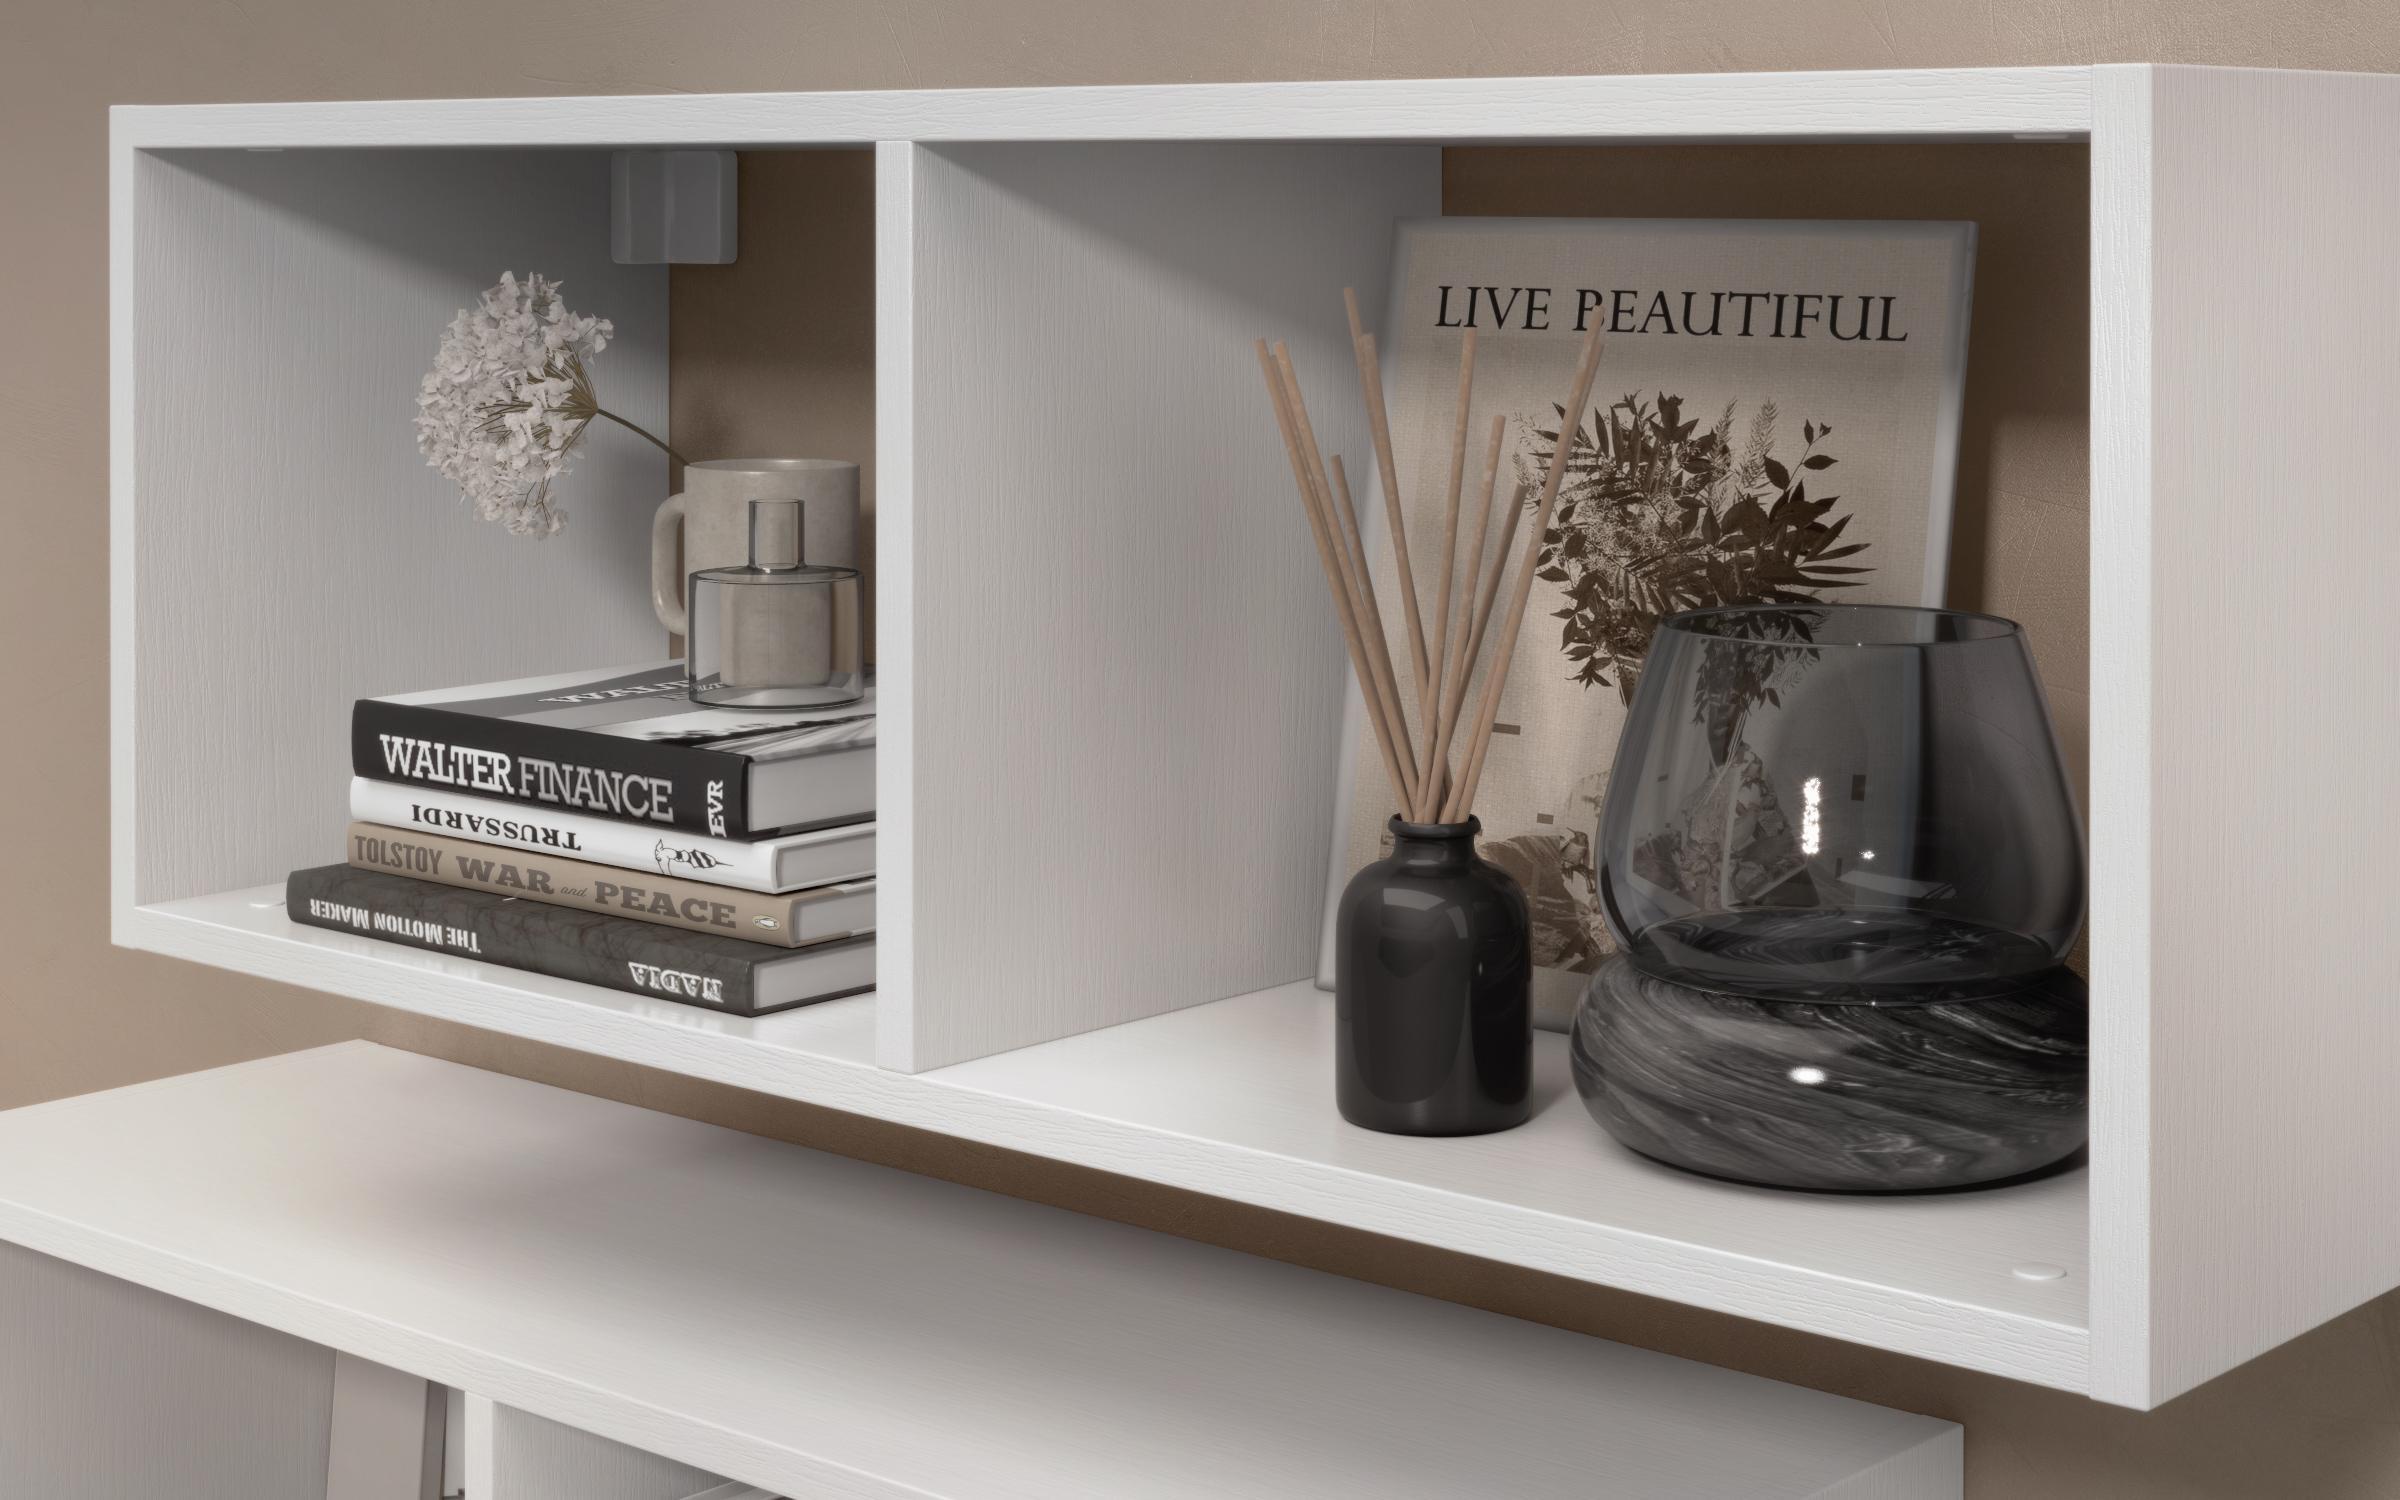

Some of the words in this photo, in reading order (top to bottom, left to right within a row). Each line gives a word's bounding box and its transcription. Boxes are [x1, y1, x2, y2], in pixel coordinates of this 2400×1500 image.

[1435, 285, 1553, 331] LIVE
[379, 733, 515, 795] WALTER
[517, 756, 674, 823] FINANCE
[411, 804, 582, 851] TRUSSARDI
[707, 779, 727, 838] EVR
[355, 835, 443, 875] TOLSTOY
[456, 855, 555, 895] WAR
[560, 886, 588, 898] and
[594, 880, 737, 929] PEACE
[309, 898, 370, 931] MAKER
[373, 911, 444, 946] MOTION
[446, 926, 482, 954] THE
[628, 961, 724, 1003] NADIA
